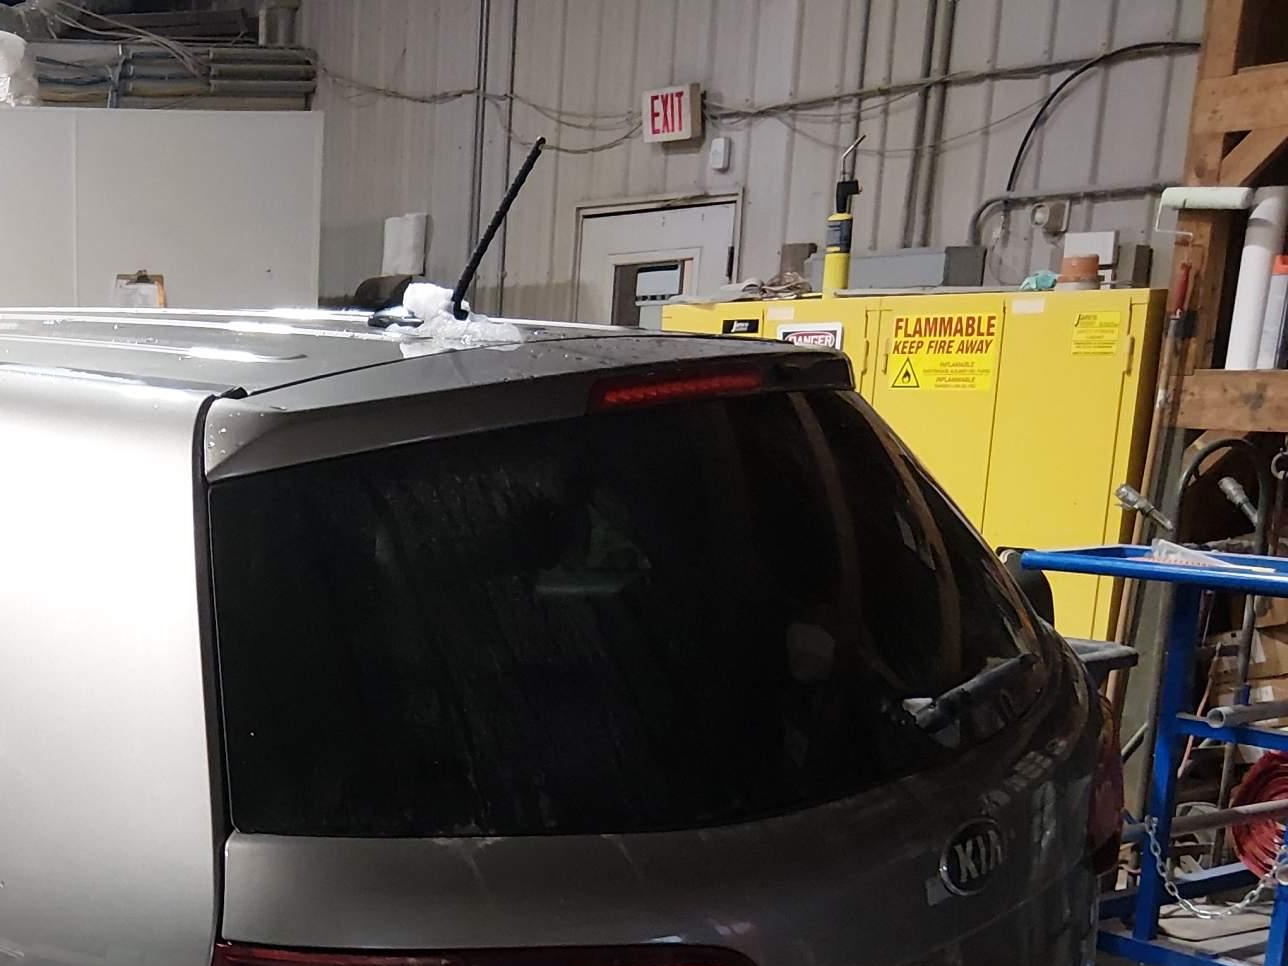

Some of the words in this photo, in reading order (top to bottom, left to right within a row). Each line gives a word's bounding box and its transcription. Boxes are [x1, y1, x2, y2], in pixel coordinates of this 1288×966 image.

[650, 91, 684, 135] EXIT
[894, 315, 996, 338] FLAMMABLE
[892, 340, 924, 355] KEEP
[926, 340, 955, 355] FIRE
[955, 339, 994, 355] AWAY
[953, 829, 1003, 884] KIA
